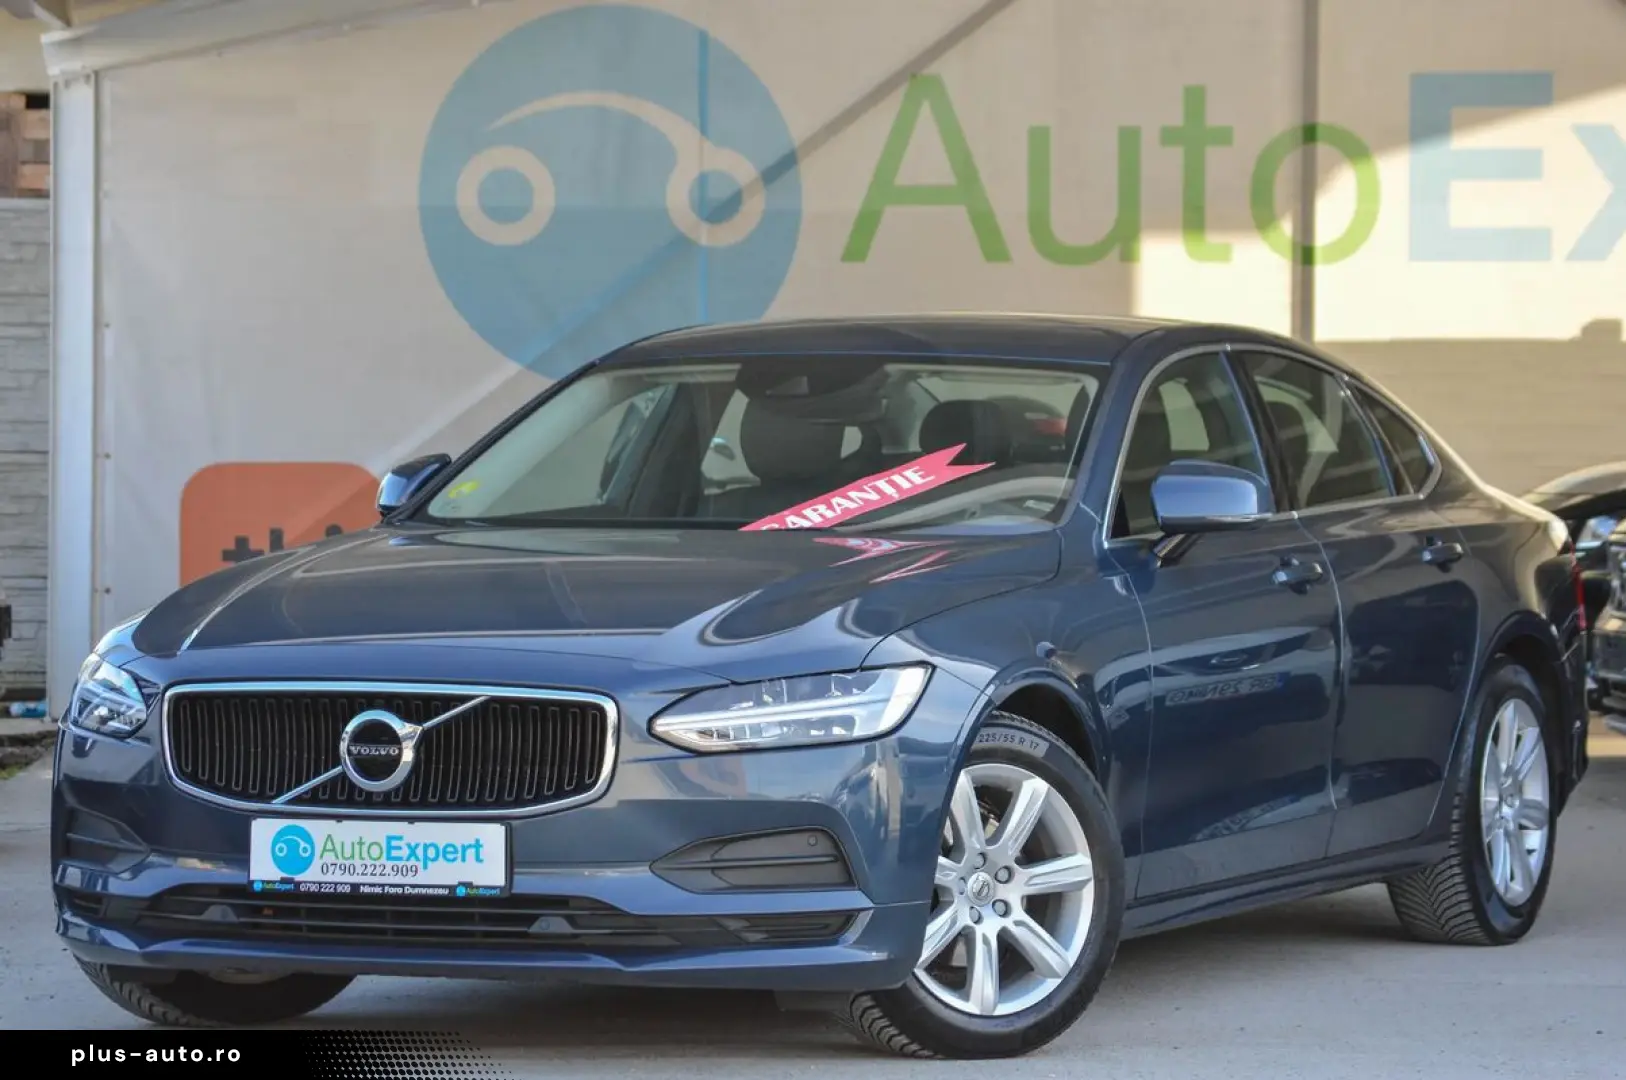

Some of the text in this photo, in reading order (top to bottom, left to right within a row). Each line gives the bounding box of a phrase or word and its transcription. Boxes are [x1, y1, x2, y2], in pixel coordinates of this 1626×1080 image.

[979, 733, 1016, 743] 225/55
[349, 745, 400, 756] VOLVO
[319, 833, 484, 870] AutoExpert
[321, 863, 419, 878] 0790.222.909
[300, 883, 351, 893] 0790 222 909
[360, 884, 382, 893] Nimic
[404, 886, 449, 895] Dumnezeu
